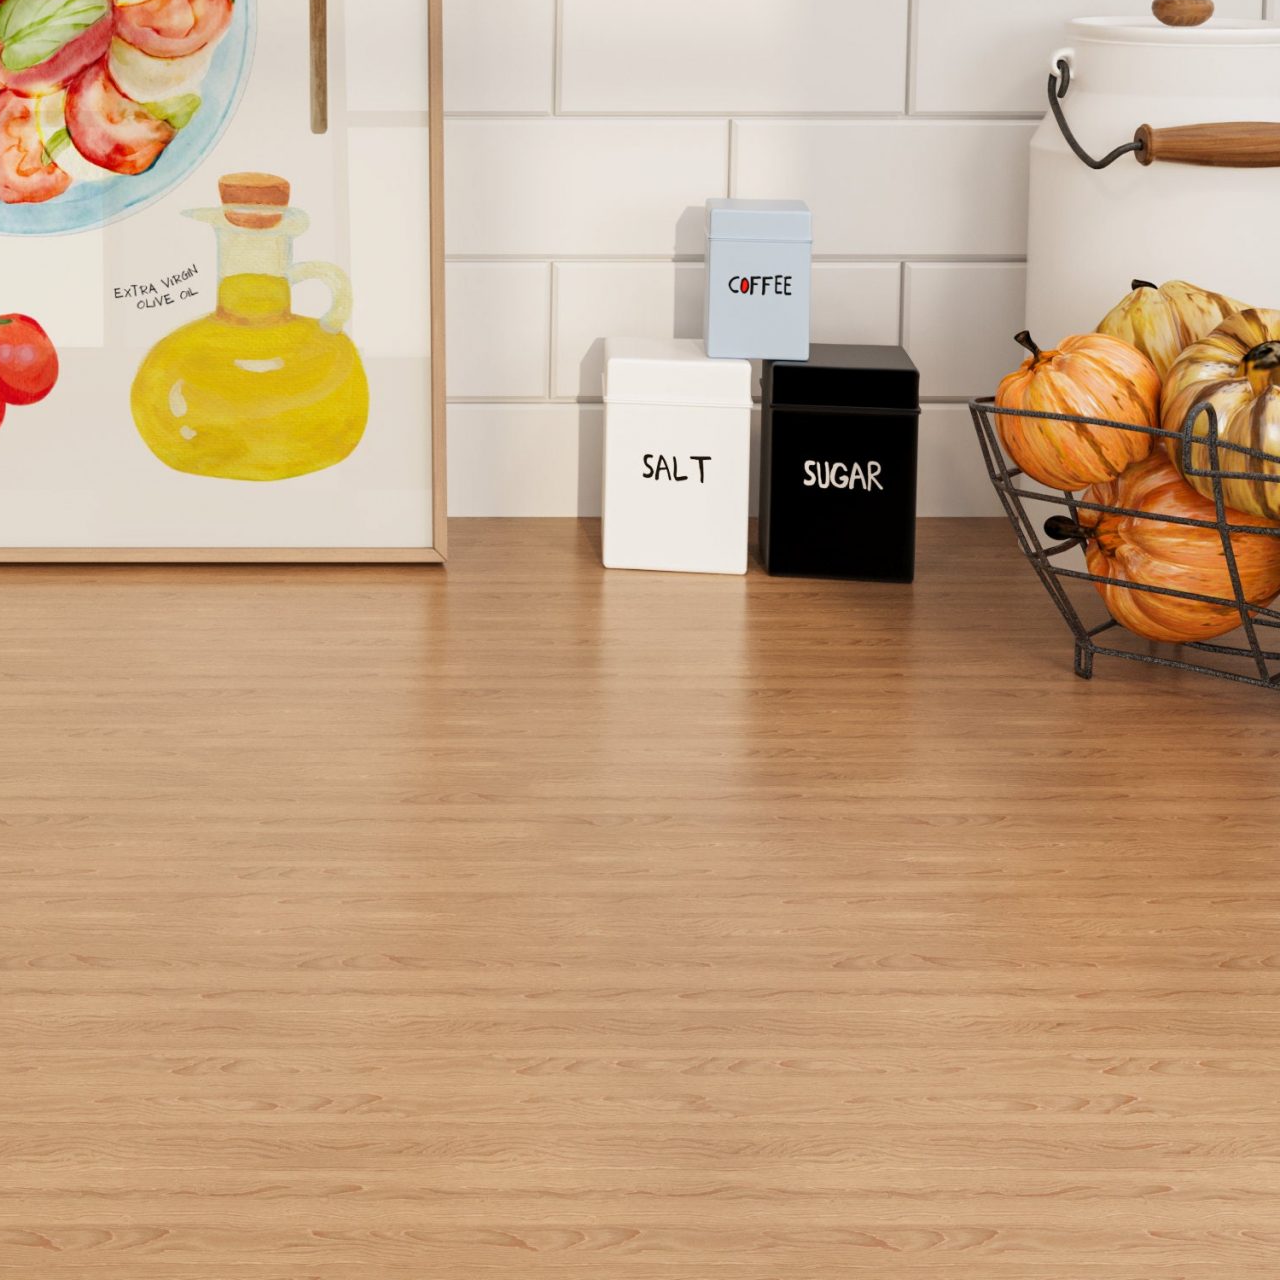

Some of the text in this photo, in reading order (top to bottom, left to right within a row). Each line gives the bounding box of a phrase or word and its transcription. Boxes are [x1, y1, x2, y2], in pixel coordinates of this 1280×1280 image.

[113, 263, 199, 299] EXTRA VIRGIN
[728, 275, 792, 296] COFFEE
[136, 287, 199, 310] OLIVE OIL
[642, 454, 712, 483] SALT
[804, 459, 884, 492] SUGAR
